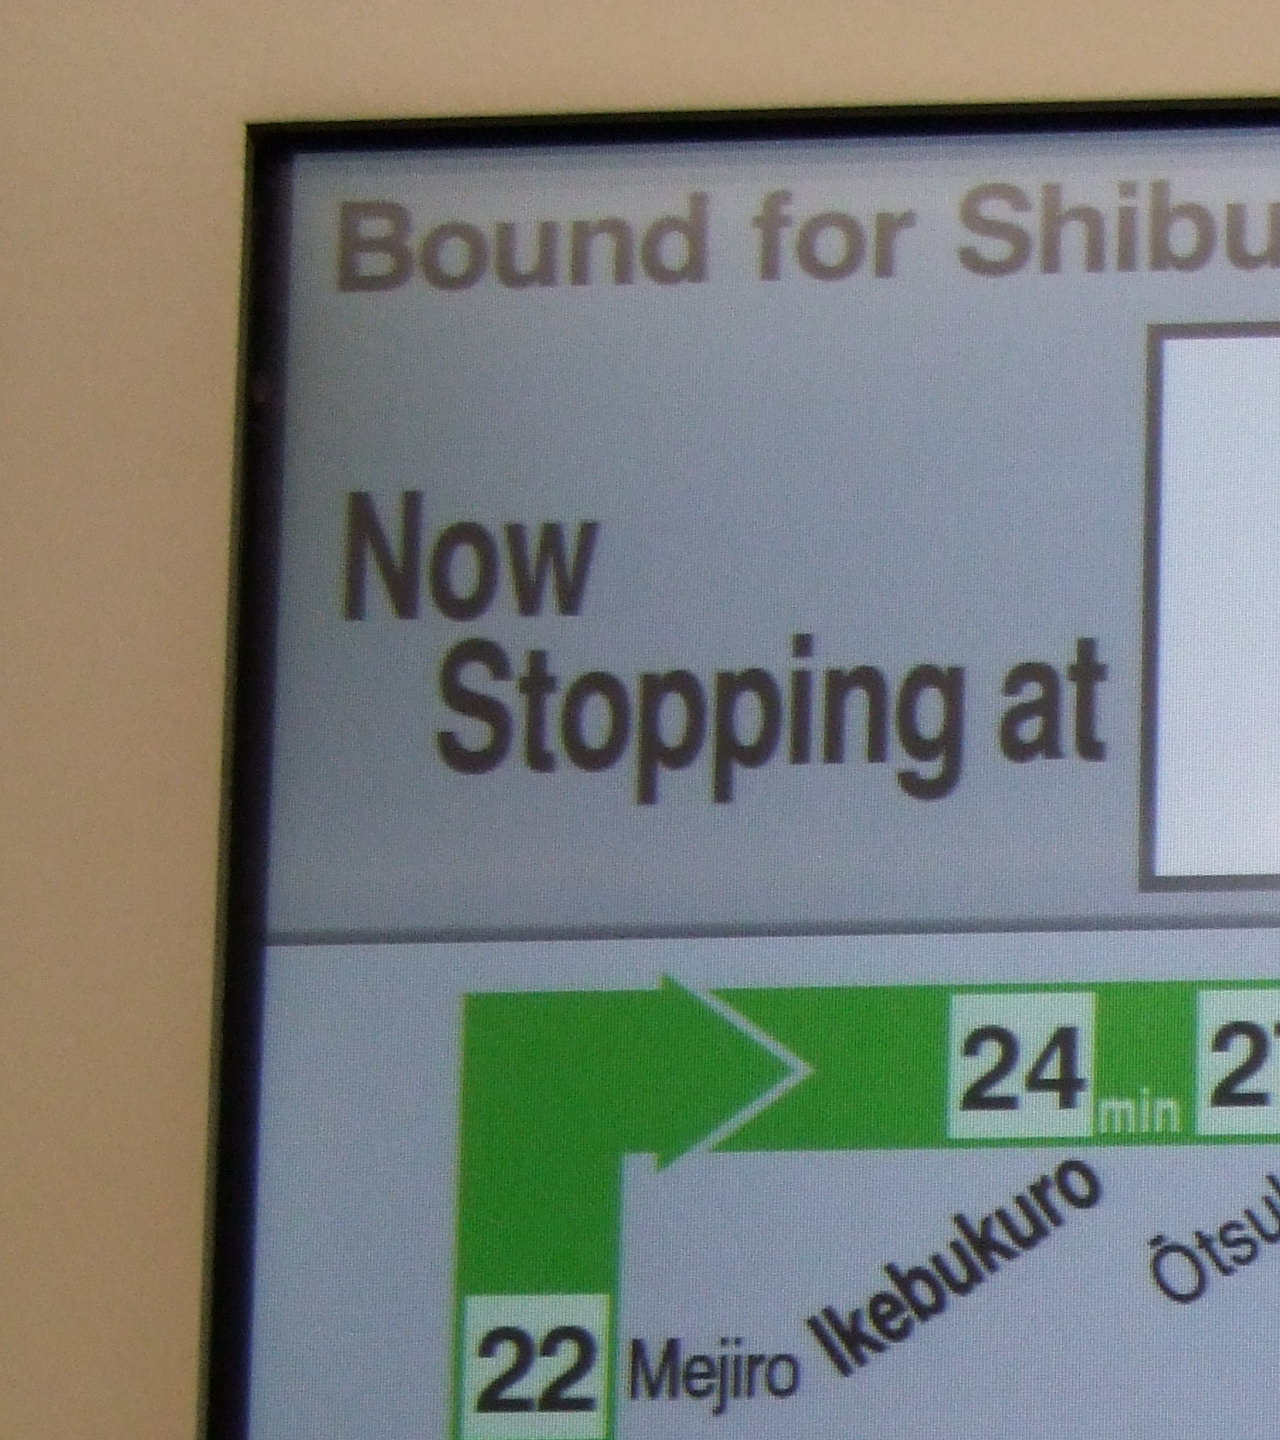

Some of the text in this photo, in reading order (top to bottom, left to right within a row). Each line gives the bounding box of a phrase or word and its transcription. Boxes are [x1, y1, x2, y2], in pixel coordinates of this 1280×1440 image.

[336, 190, 710, 296] Bound
[753, 187, 914, 282] for
[343, 490, 598, 624] Now
[435, 635, 1107, 804] Stopping at
[960, 1025, 1180, 1134] 24 min
[805, 1156, 1105, 1377] Ikebukuro
[475, 1325, 800, 1415] 22 Mejiro
